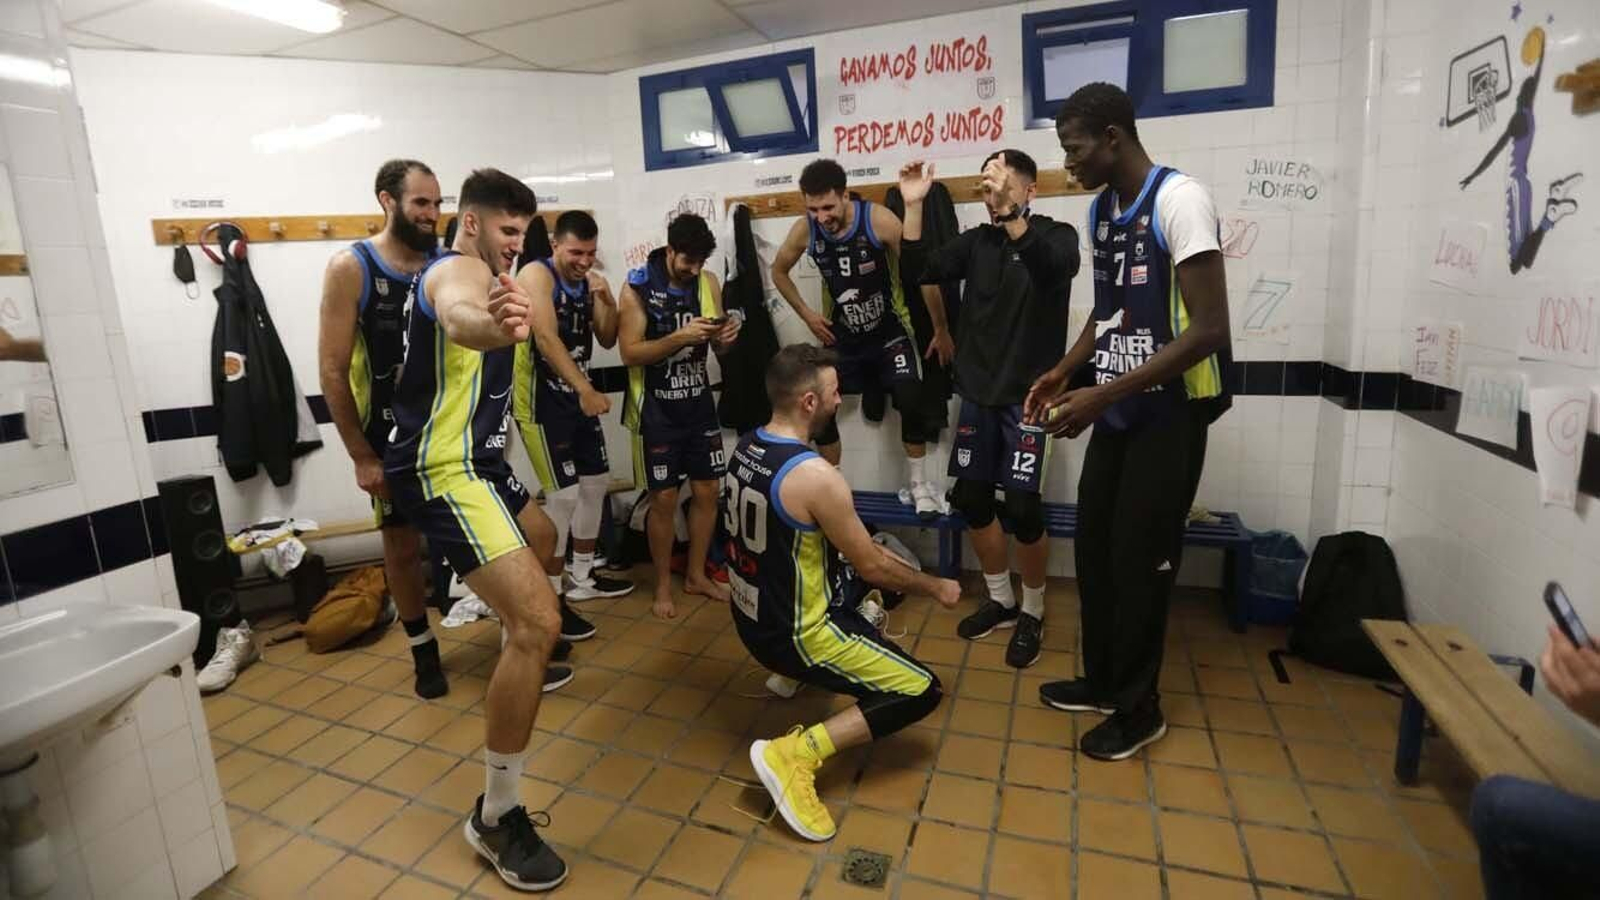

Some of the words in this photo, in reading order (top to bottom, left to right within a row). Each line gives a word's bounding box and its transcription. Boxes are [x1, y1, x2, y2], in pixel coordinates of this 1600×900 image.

[840, 45, 917, 86] GANAMOS
[925, 35, 993, 74] JUNTOS,
[834, 112, 934, 154] PERDEMOS
[940, 105, 1003, 143] JUNTOS
[1246, 159, 1311, 178] JAVIER
[1247, 180, 1318, 200] ROMERO
[838, 256, 851, 277] 9
[1113, 252, 1126, 286] 7
[1527, 296, 1594, 354] JORDI
[1109, 333, 1155, 354] ENER
[676, 361, 705, 376] ENE
[894, 354, 907, 368] 9
[671, 374, 705, 389] DRIN
[710, 450, 724, 467] 10
[1011, 451, 1036, 474] 12
[724, 472, 768, 554] 30
